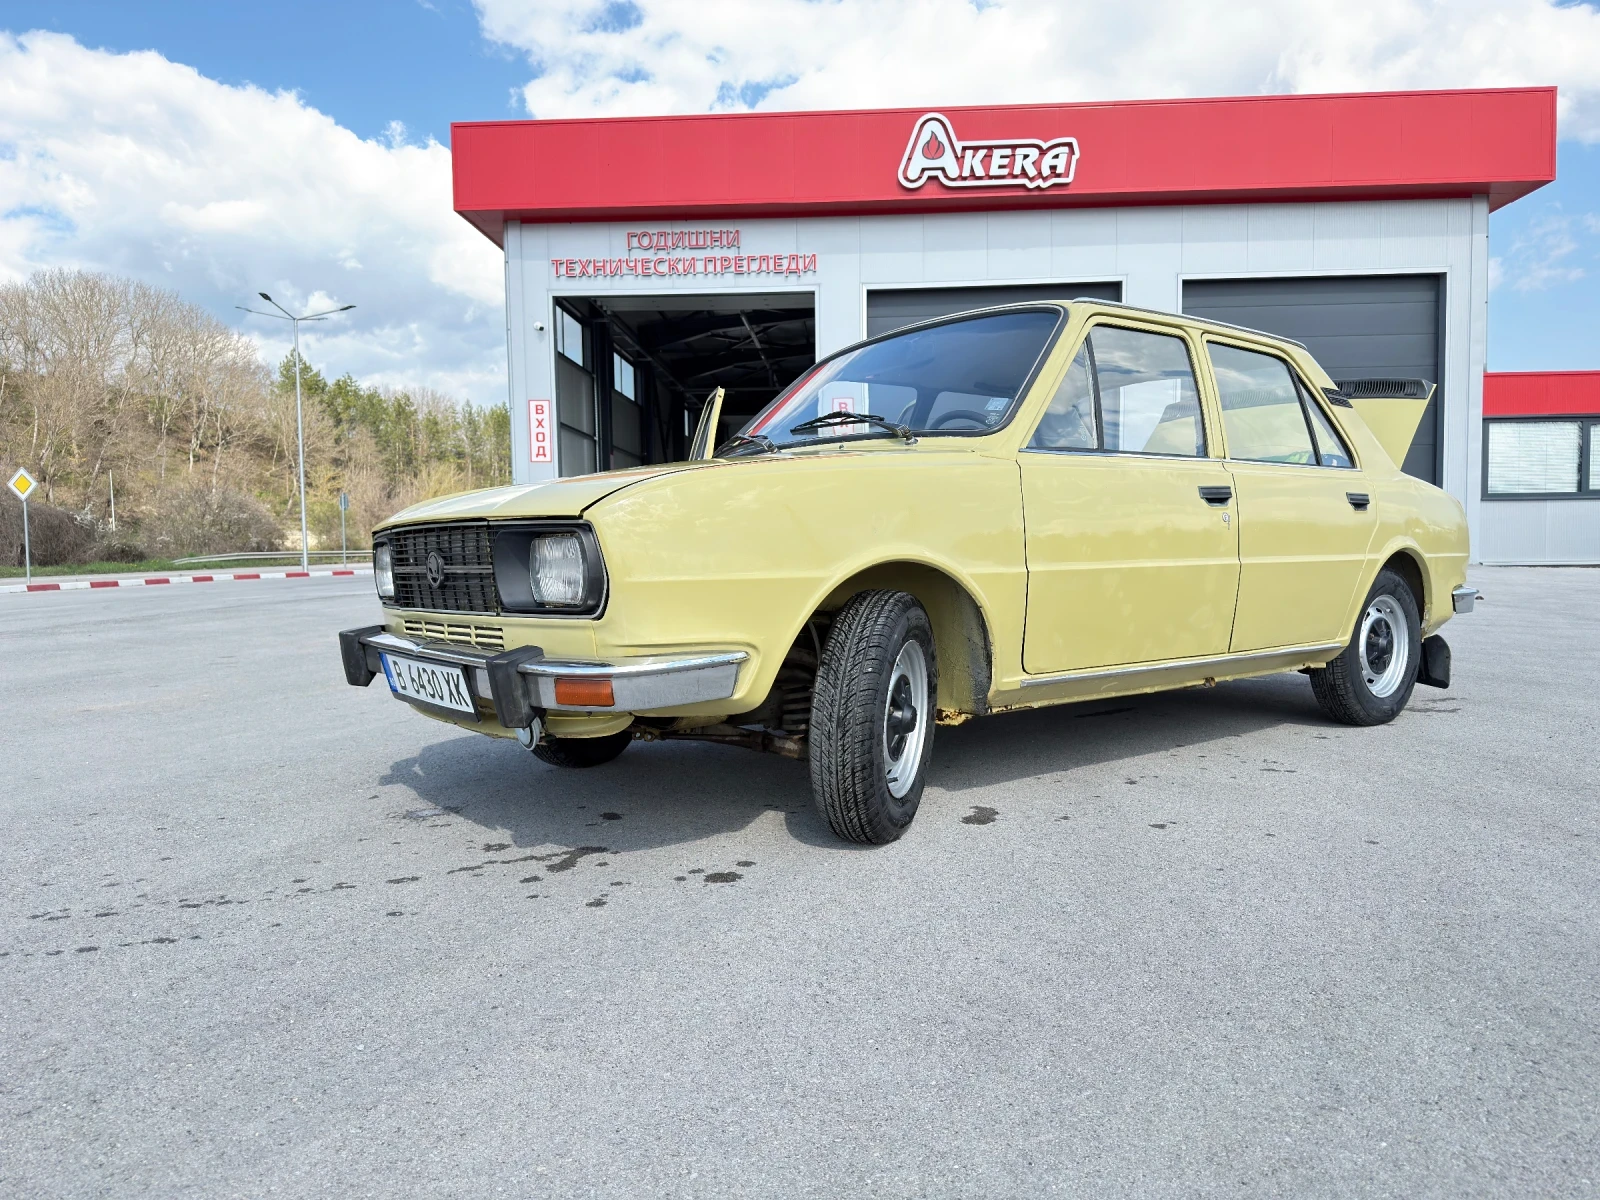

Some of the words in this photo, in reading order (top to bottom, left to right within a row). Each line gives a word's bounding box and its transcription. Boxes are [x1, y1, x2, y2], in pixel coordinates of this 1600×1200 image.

[905, 118, 1070, 180] AKERA
[551, 256, 697, 277] ТЕХНИЧЕСКИ
[703, 253, 817, 276] ПРЕГЛЕДИ
[626, 230, 741, 253] ГОДИШНИ
[535, 404, 547, 458] ВХОД
[392, 660, 407, 690] B
[408, 664, 444, 701] 6430
[440, 670, 470, 707] XK
